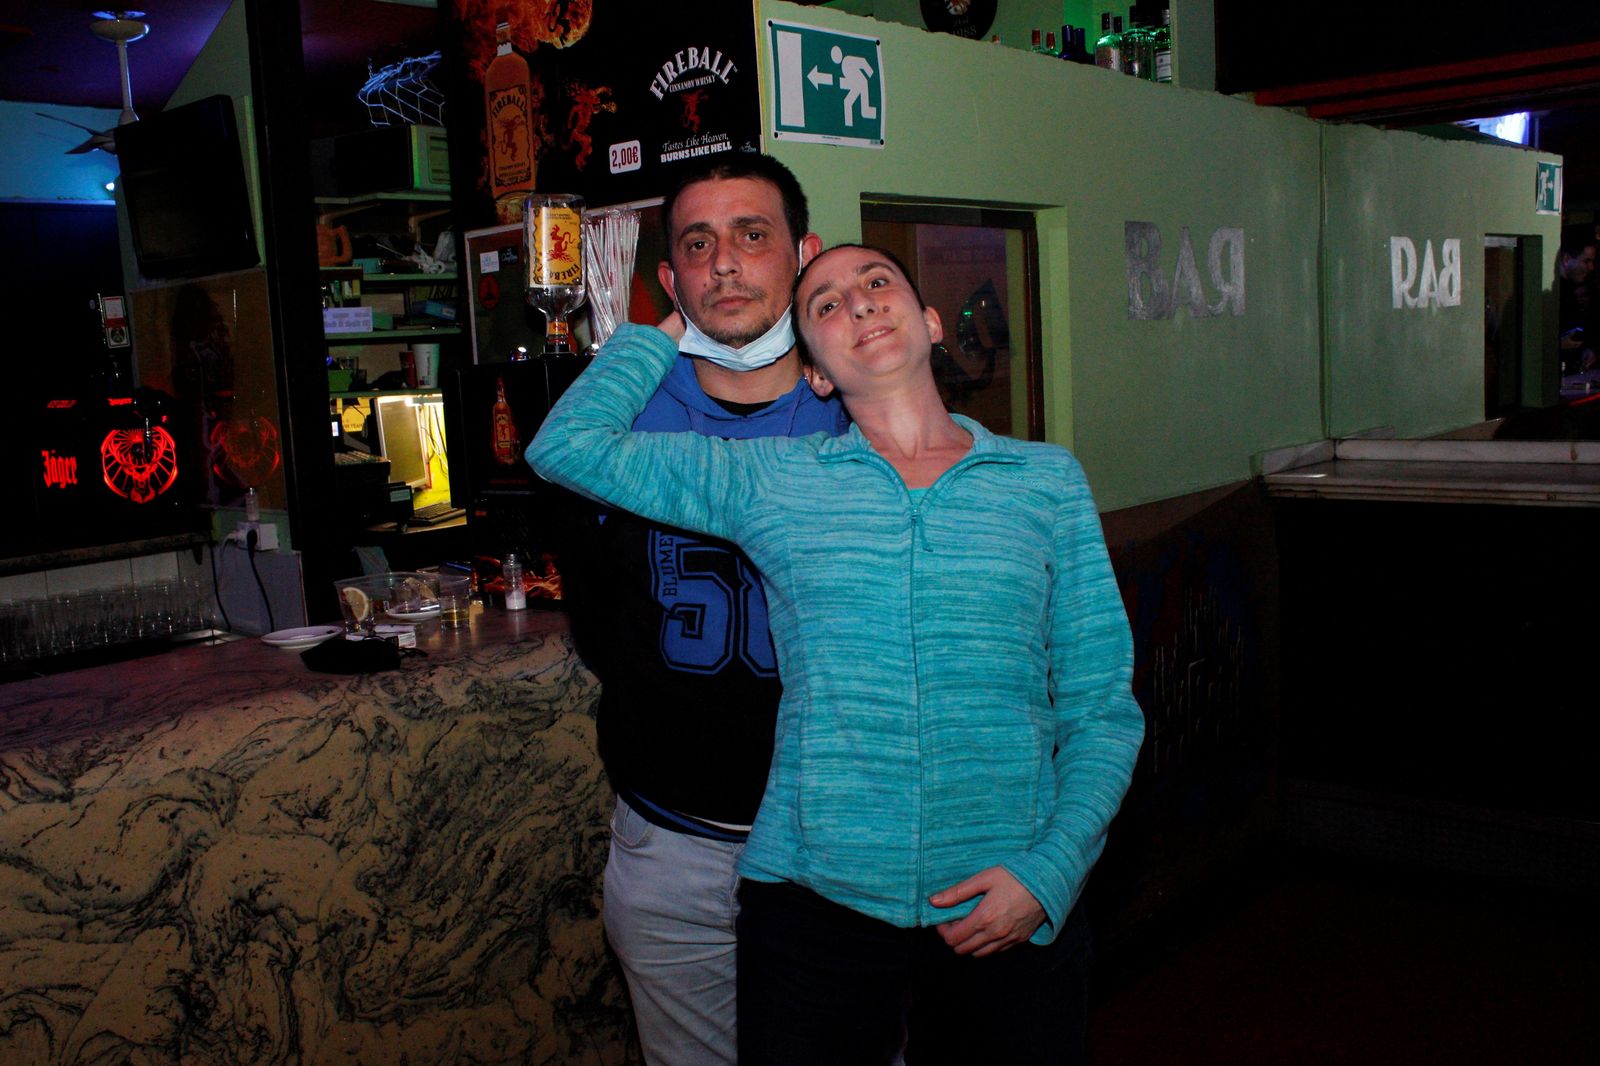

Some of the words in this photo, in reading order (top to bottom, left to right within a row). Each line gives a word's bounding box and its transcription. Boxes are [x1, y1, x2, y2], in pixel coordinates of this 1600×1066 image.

[649, 46, 735, 101] FIREBALL
[669, 79, 695, 93] CINNAMON
[695, 74, 716, 86] WHISKY
[660, 150, 690, 164] BURNS
[690, 145, 710, 157] LIKE
[710, 140, 733, 154] HELL
[662, 139, 684, 152] Tastes
[685, 134, 700, 148] Like
[611, 145, 639, 168] 2,00€
